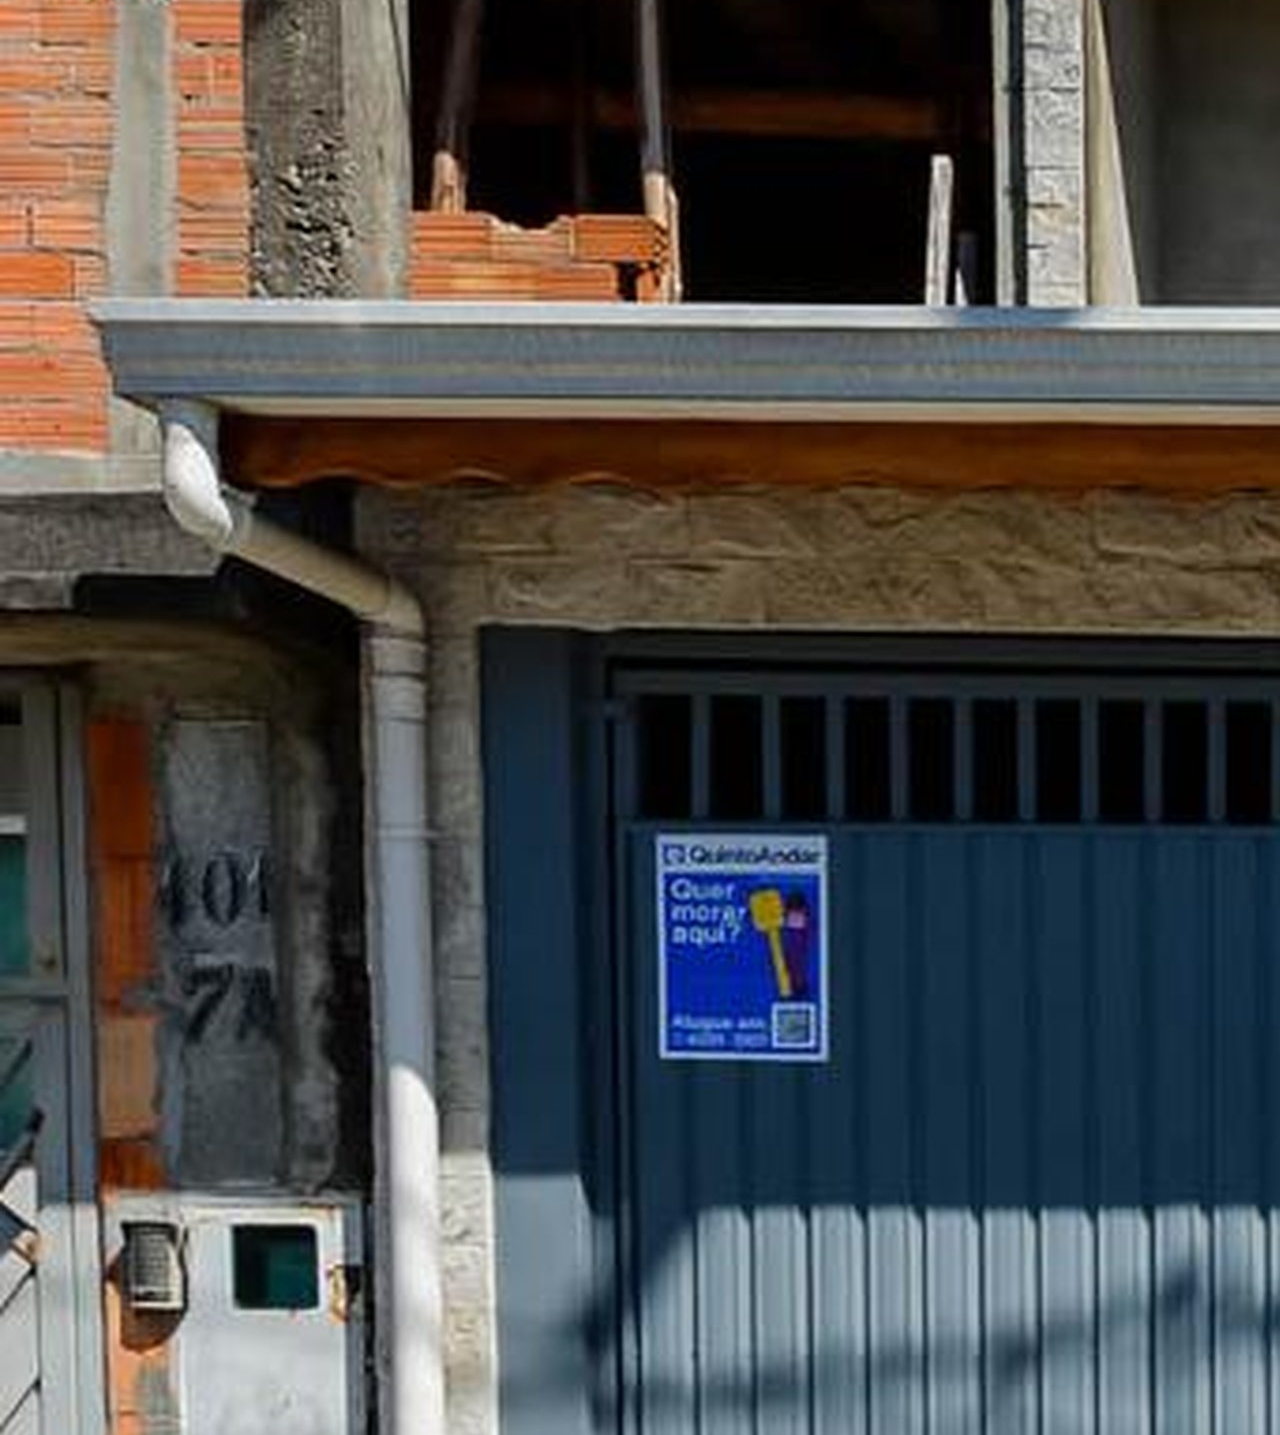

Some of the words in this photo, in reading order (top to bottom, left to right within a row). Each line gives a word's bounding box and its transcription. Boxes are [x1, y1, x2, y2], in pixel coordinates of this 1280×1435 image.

[670, 878, 735, 901] Quer
[670, 904, 747, 922] morar
[671, 923, 741, 947] aqui?
